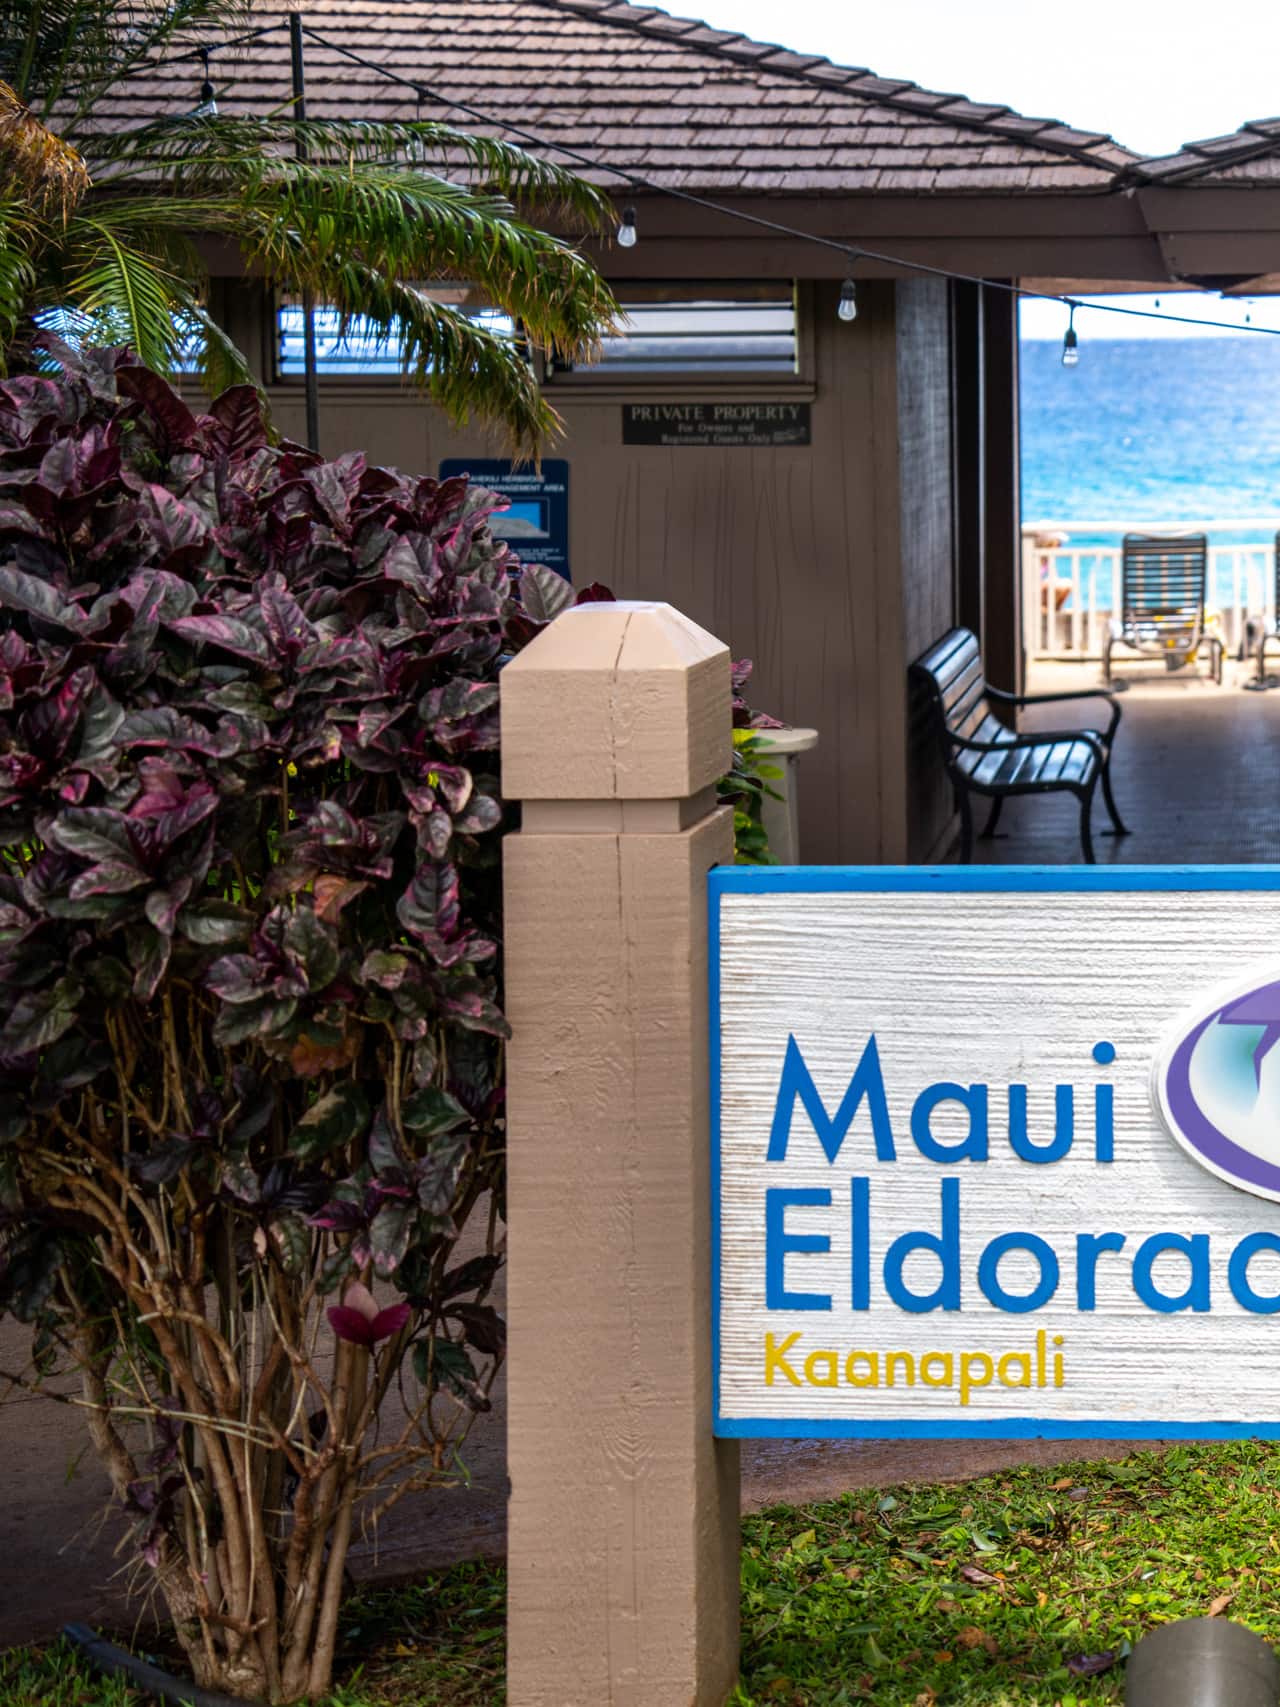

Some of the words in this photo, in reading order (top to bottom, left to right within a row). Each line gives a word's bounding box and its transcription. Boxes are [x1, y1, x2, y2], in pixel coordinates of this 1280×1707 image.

[631, 405, 704, 421] PRIVATE
[713, 405, 799, 421] PROPERTY
[543, 483, 565, 492] AREA
[766, 1031, 1115, 1165] Maui
[763, 1330, 1066, 1406] Kaanapali
